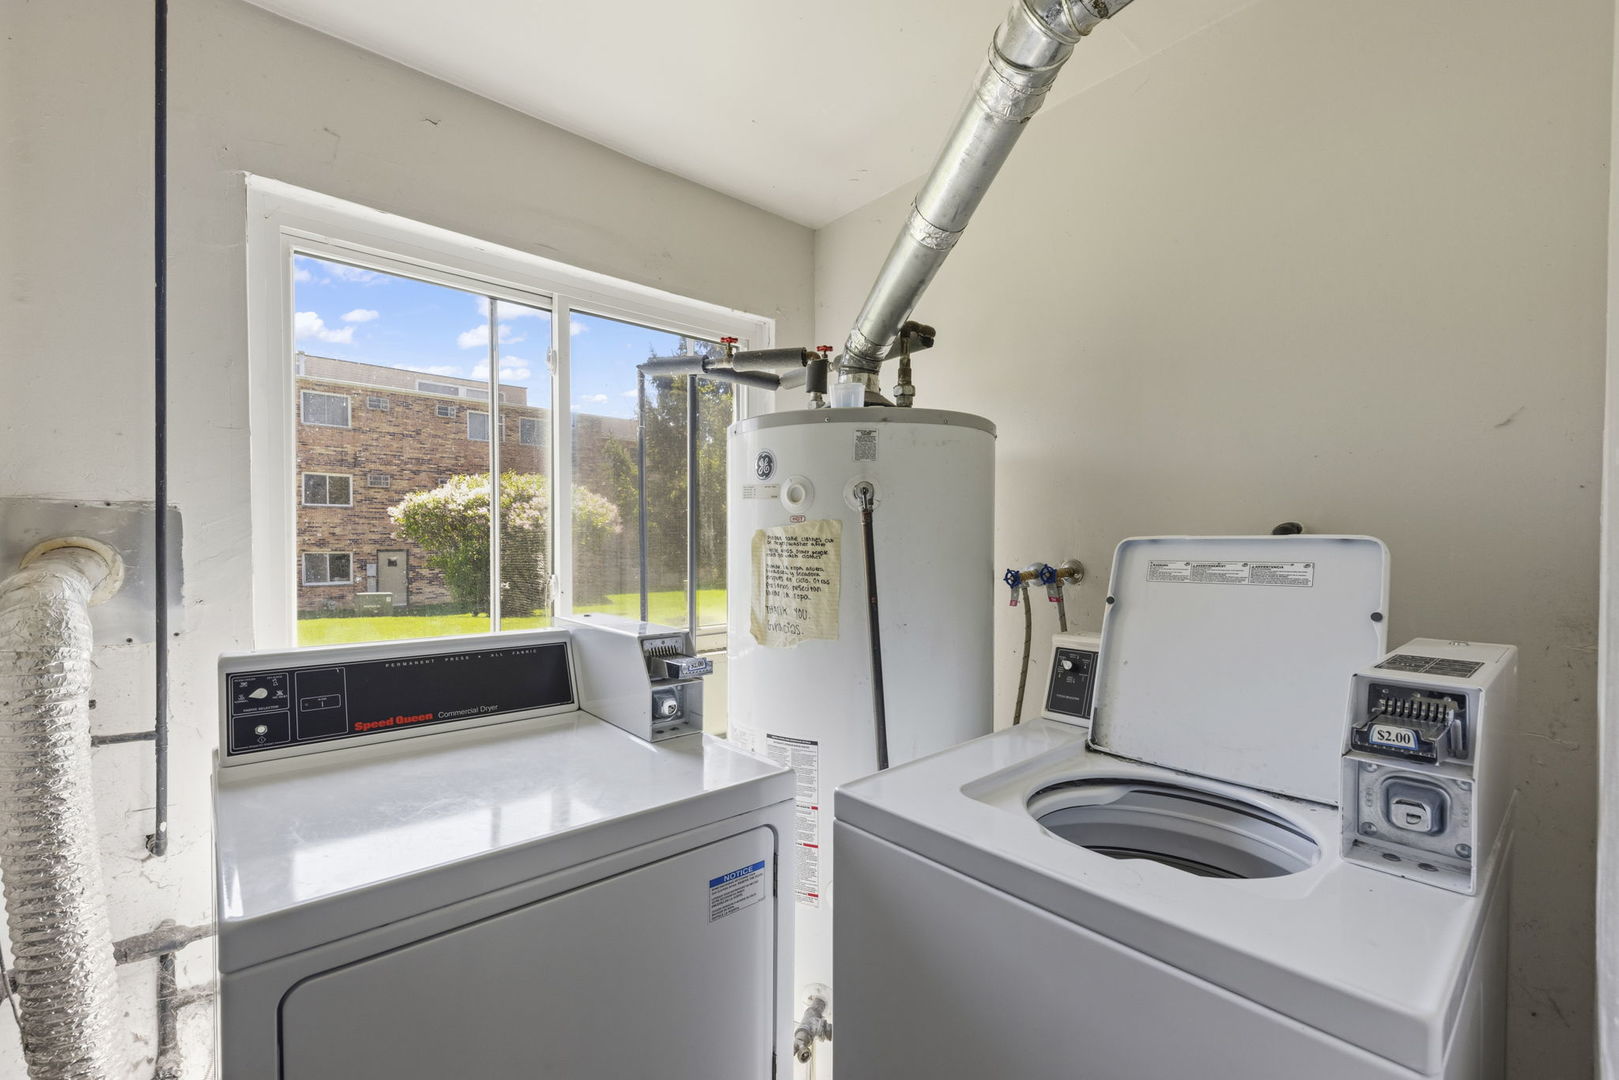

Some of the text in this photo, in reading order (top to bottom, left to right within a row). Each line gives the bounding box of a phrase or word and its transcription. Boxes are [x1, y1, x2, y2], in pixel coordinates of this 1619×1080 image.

[385, 659, 435, 668] PERMANENT
[445, 655, 470, 663] PRESS
[354, 704, 499, 731] Speed Queen Commercial Dryer
[1377, 729, 1412, 745] $2.00
[723, 865, 753, 882] NOTICE
